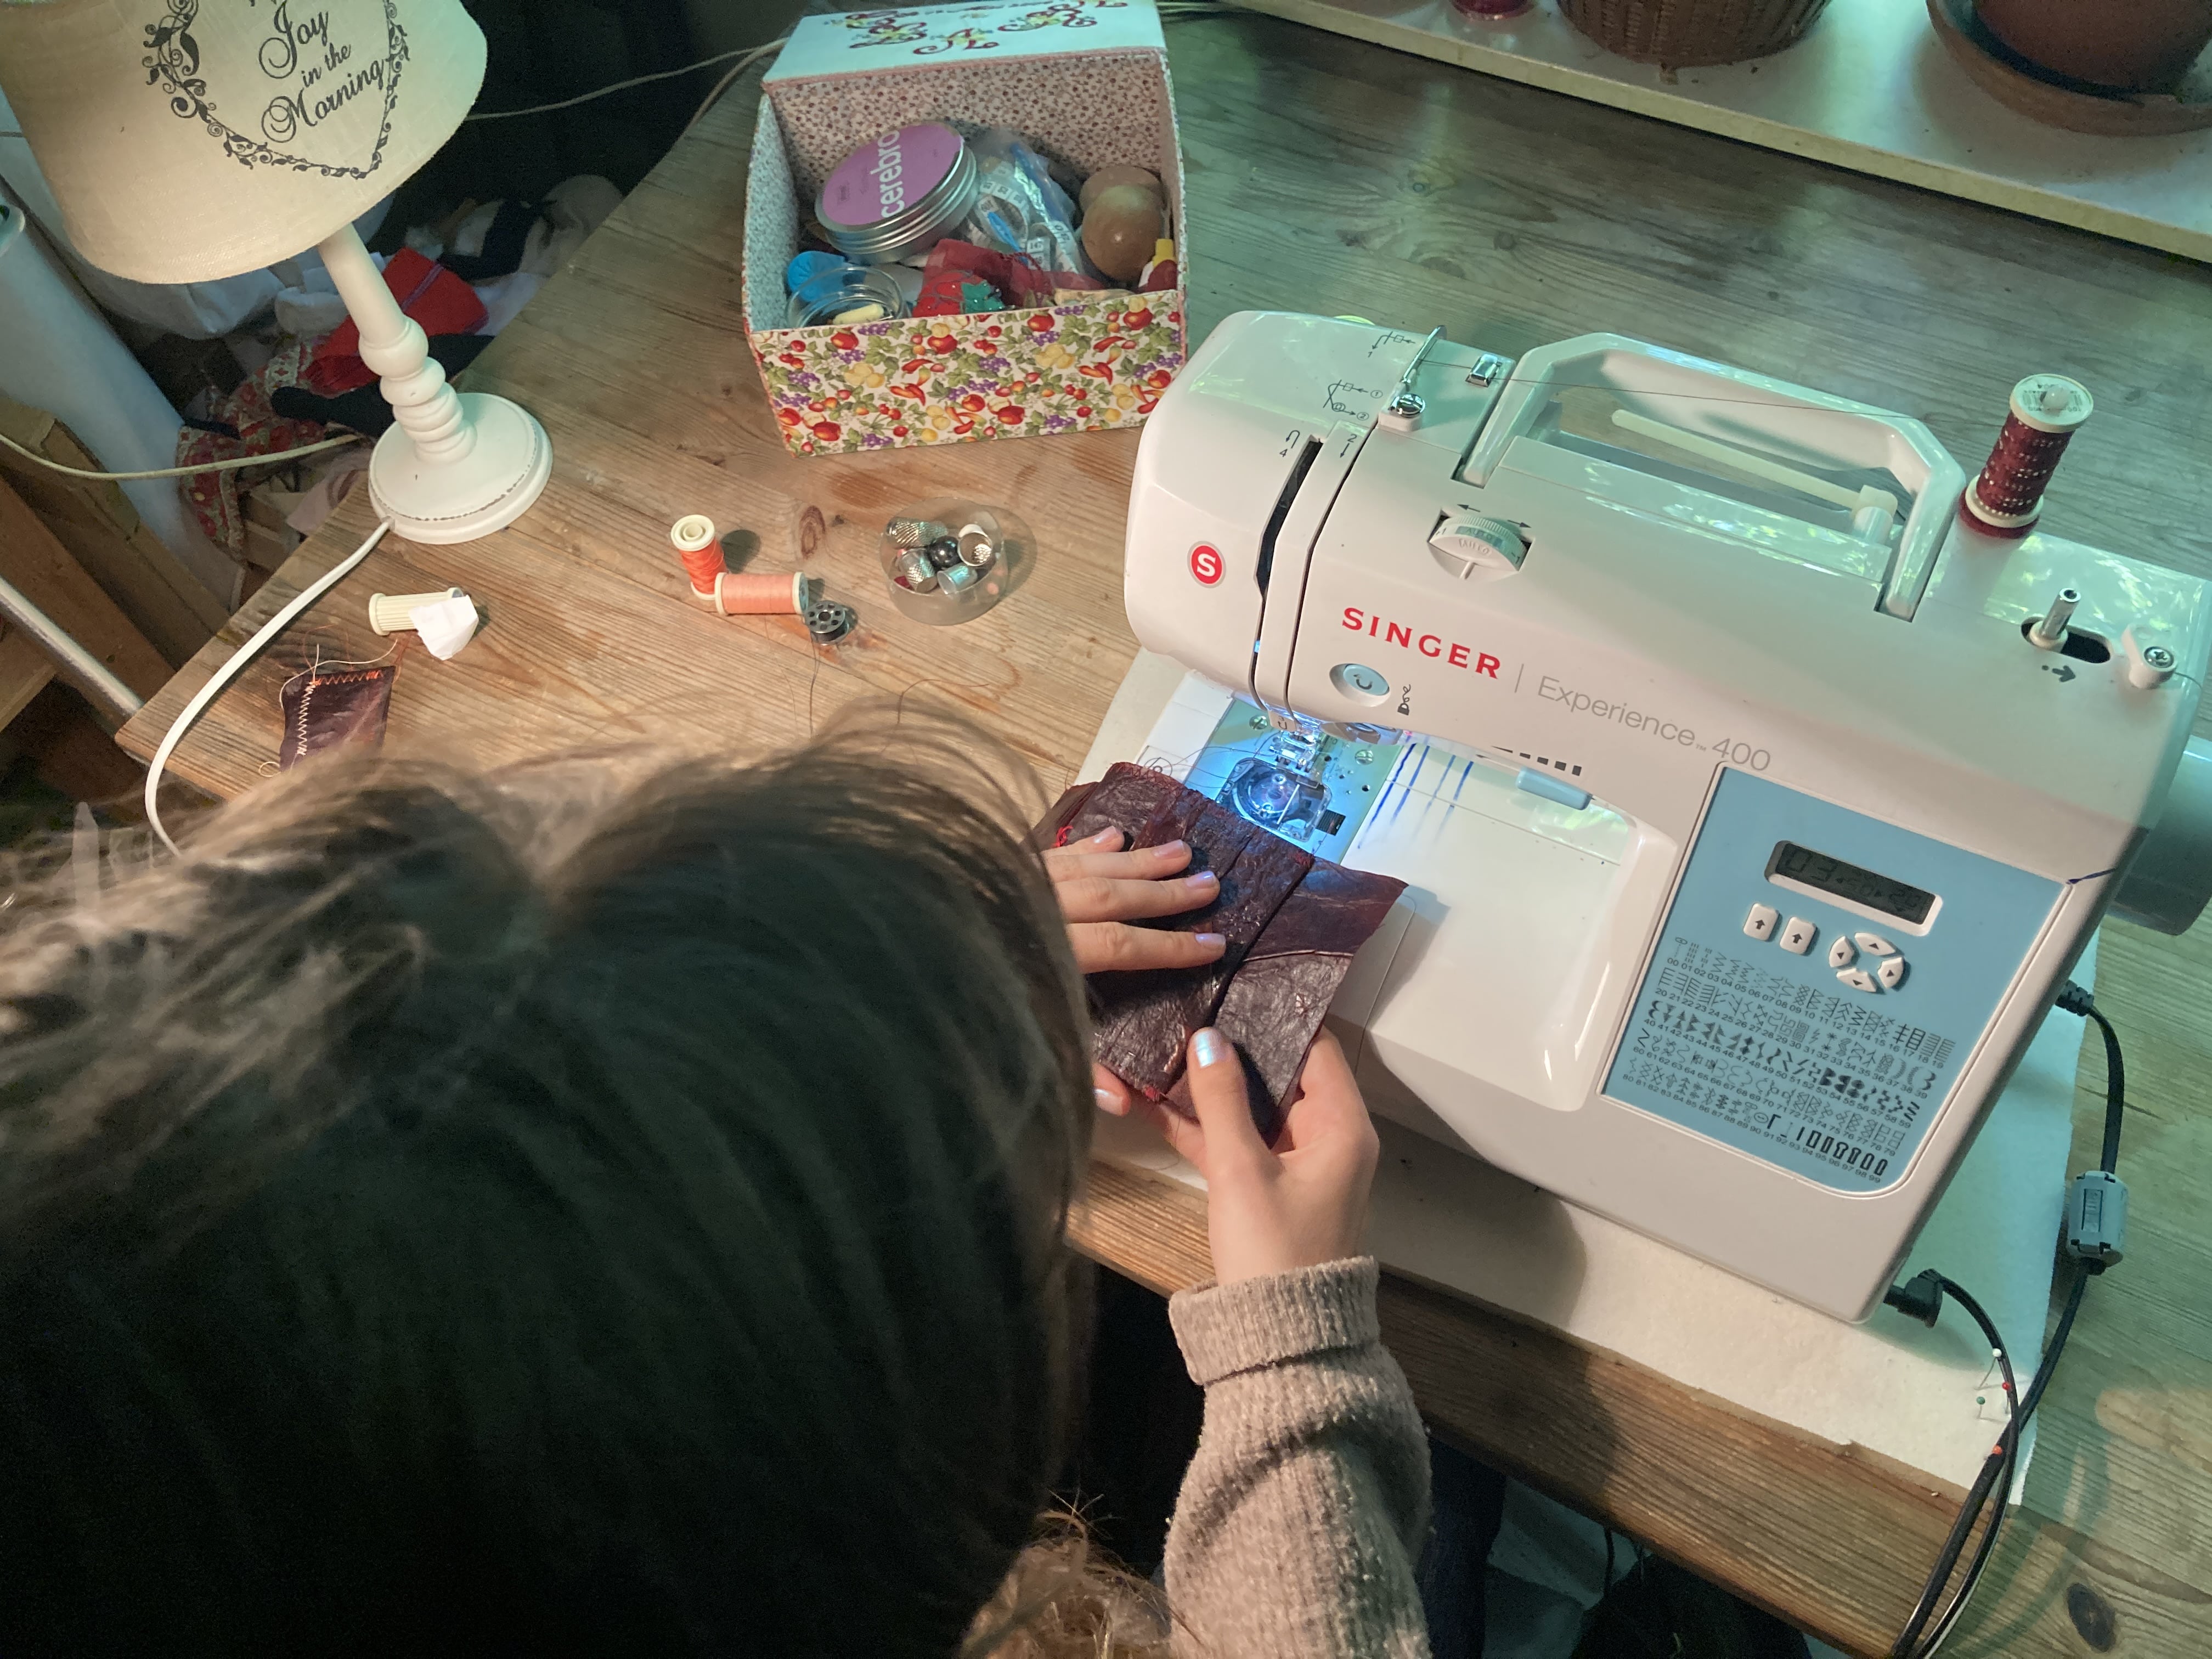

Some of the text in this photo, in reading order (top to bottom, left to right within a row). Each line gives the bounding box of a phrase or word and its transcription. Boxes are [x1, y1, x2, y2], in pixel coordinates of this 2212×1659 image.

[259, 0, 328, 78] Joy
[301, 42, 351, 88] in the
[261, 59, 384, 143] Morning
[870, 130, 905, 218] cerebro
[1279, 449, 1288, 458] 4
[1347, 434, 1357, 443] 2
[1196, 552, 1217, 577] S
[1342, 607, 1502, 679] SINGER
[1538, 675, 1695, 747] Experience
[1712, 738, 1771, 771] 400
[1655, 988, 1667, 997] 20
[1668, 993, 1680, 1002] 21
[1681, 998, 1694, 1007] 22
[1695, 1003, 1707, 1012] 23
[1708, 1008, 1720, 1017] 24
[1721, 1014, 1733, 1023] 25
[1735, 1019, 1747, 1028] 26
[1748, 1024, 1761, 1032] 27
[1761, 1030, 1774, 1039] 28
[1775, 1035, 1788, 1044] 29
[1789, 1041, 1801, 1049] 30
[1803, 1046, 1815, 1054] 31
[1816, 1051, 1829, 1060] 32
[1830, 1057, 1843, 1065] 33
[1844, 1062, 1856, 1071] 34
[1858, 1068, 1870, 1076] 35
[1872, 1073, 1884, 1082] 36
[1900, 1084, 1913, 1093] 38
[1914, 1089, 1927, 1098] 39
[1667, 957, 1679, 966] 00
[1681, 963, 1692, 972] 01
[1694, 968, 1706, 977] 02
[1707, 973, 1719, 982] 03
[1720, 978, 1733, 986] 04
[1734, 984, 1747, 992] 05
[1748, 989, 1760, 997] 06
[1775, 1000, 1788, 1008] 08
[1789, 1005, 1802, 1013] 09
[1805, 1011, 1815, 1019] 10
[1820, 1016, 1829, 1024] 11
[1833, 1022, 1843, 1030] 12
[1847, 1027, 1857, 1035] 13
[1875, 1038, 1886, 1046] 15
[1889, 1043, 1900, 1052] 16
[1903, 1048, 1915, 1057] 17
[1918, 1054, 1929, 1063] 18
[1932, 1060, 1944, 1069] 19
[1622, 1074, 1634, 1082] 80
[1647, 1084, 1659, 1092] 82
[1660, 1089, 1672, 1097] 83
[1673, 1094, 1684, 1102] 84
[1685, 1099, 1696, 1107] 85
[1699, 1104, 1710, 1113] 86
[1724, 1115, 1735, 1123] 88
[1736, 1120, 1748, 1128] 89
[1750, 1126, 1761, 1134] 90
[1776, 1136, 1787, 1145] 92
[1789, 1142, 1801, 1150] 93
[1802, 1147, 1813, 1155] 94
[1815, 1153, 1826, 1161] 95
[1829, 1158, 1840, 1166] 96
[1842, 1164, 1854, 1172] 97
[1855, 1169, 1867, 1178] 98
[1869, 1175, 1881, 1183] 99
[1633, 1046, 1644, 1054] 60
[1658, 1057, 1670, 1065] 62
[1672, 1062, 1683, 1070] 63
[1684, 1067, 1695, 1075] 64
[1710, 1077, 1722, 1086] 66
[1736, 1088, 1748, 1096] 68
[1749, 1093, 1761, 1102] 69
[1763, 1098, 1774, 1107] 70
[1776, 1104, 1787, 1113] 71
[1789, 1109, 1801, 1118] 72
[1802, 1114, 1814, 1123] 73
[1816, 1120, 1826, 1128] 74
[1830, 1126, 1840, 1134] 75
[1843, 1131, 1854, 1139] 76
[1857, 1136, 1868, 1144] 77
[1870, 1142, 1882, 1151] 78
[1884, 1147, 1895, 1156] 79
[1748, 1060, 1760, 1068] 48
[1775, 1070, 1787, 1079] 50
[1790, 1076, 1801, 1085] 51
[1802, 1081, 1814, 1090] 52
[1816, 1086, 1827, 1094] 53
[1829, 1092, 1841, 1101] 54
[1843, 1097, 1855, 1106] 55
[1857, 1103, 1869, 1111] 56
[1884, 1114, 1897, 1123] 58
[1898, 1119, 1911, 1128] 59
